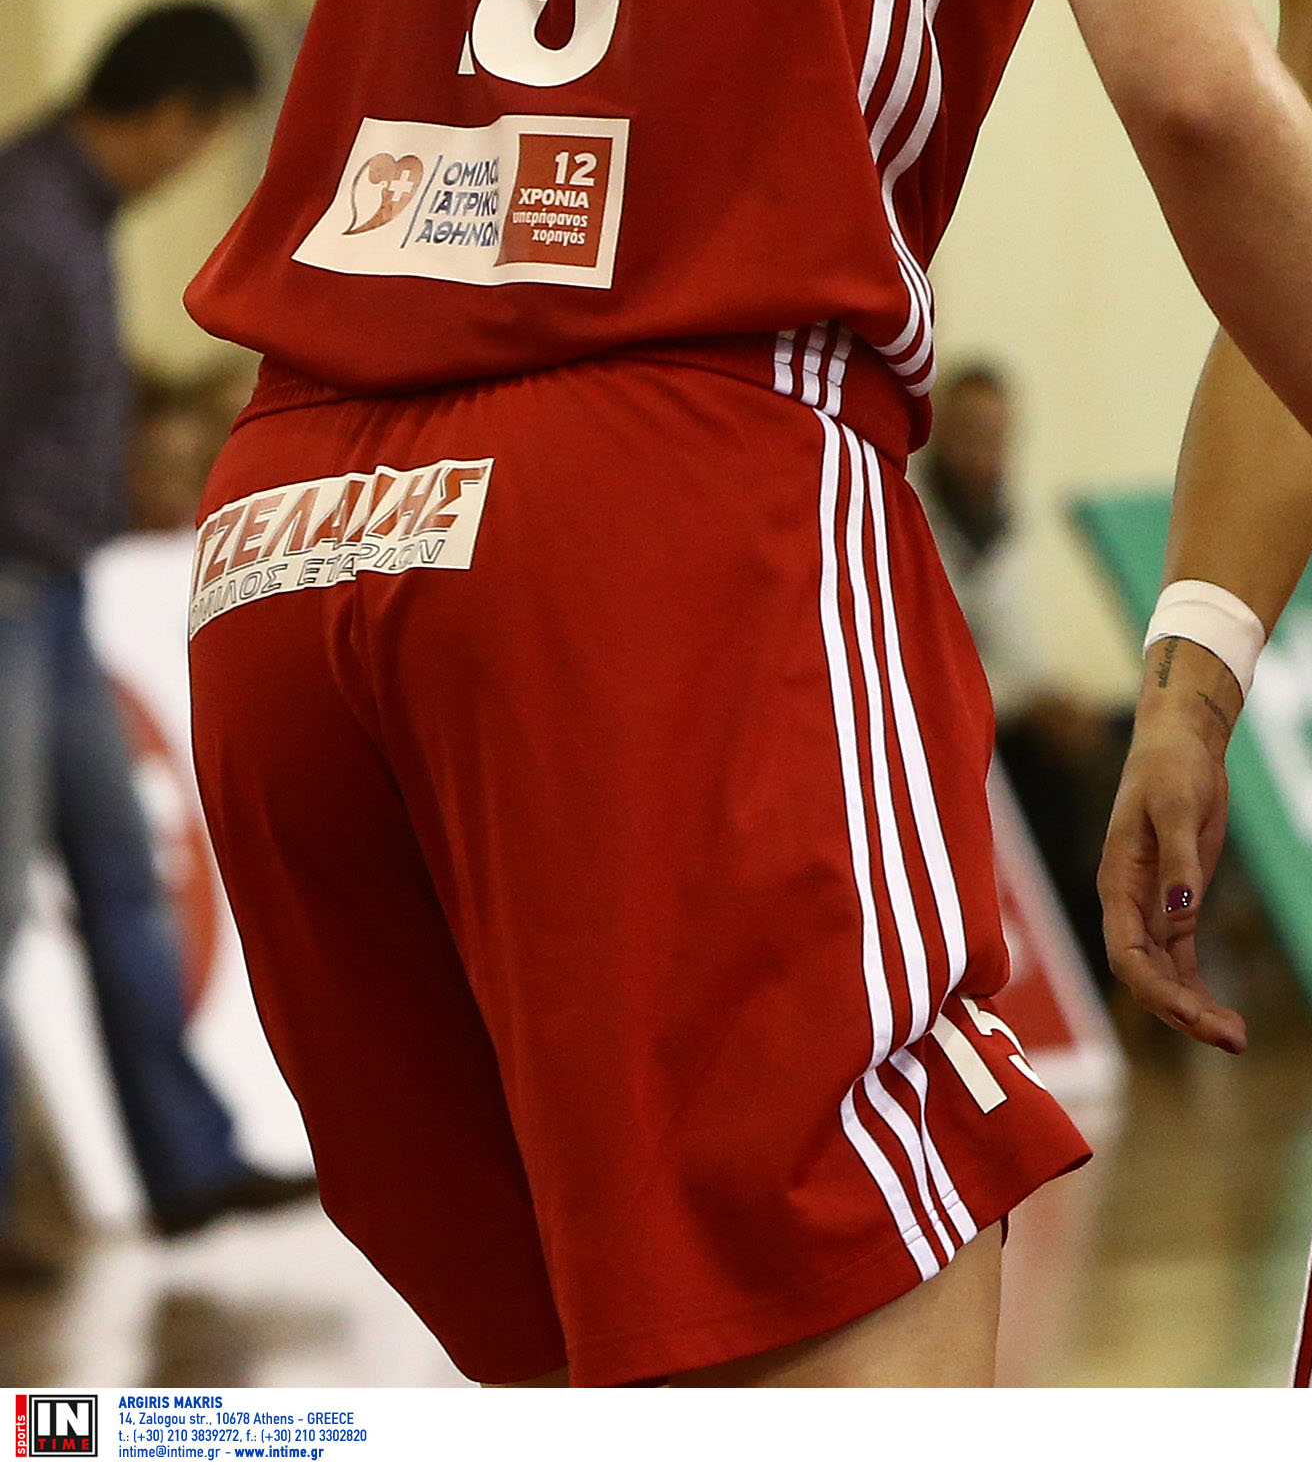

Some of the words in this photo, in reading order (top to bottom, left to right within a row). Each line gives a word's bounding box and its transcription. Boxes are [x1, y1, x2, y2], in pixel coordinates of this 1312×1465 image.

[554, 150, 598, 187] 12
[518, 187, 590, 209] ΧΡΟΝΙΑ
[531, 227, 587, 247] χορηγός
